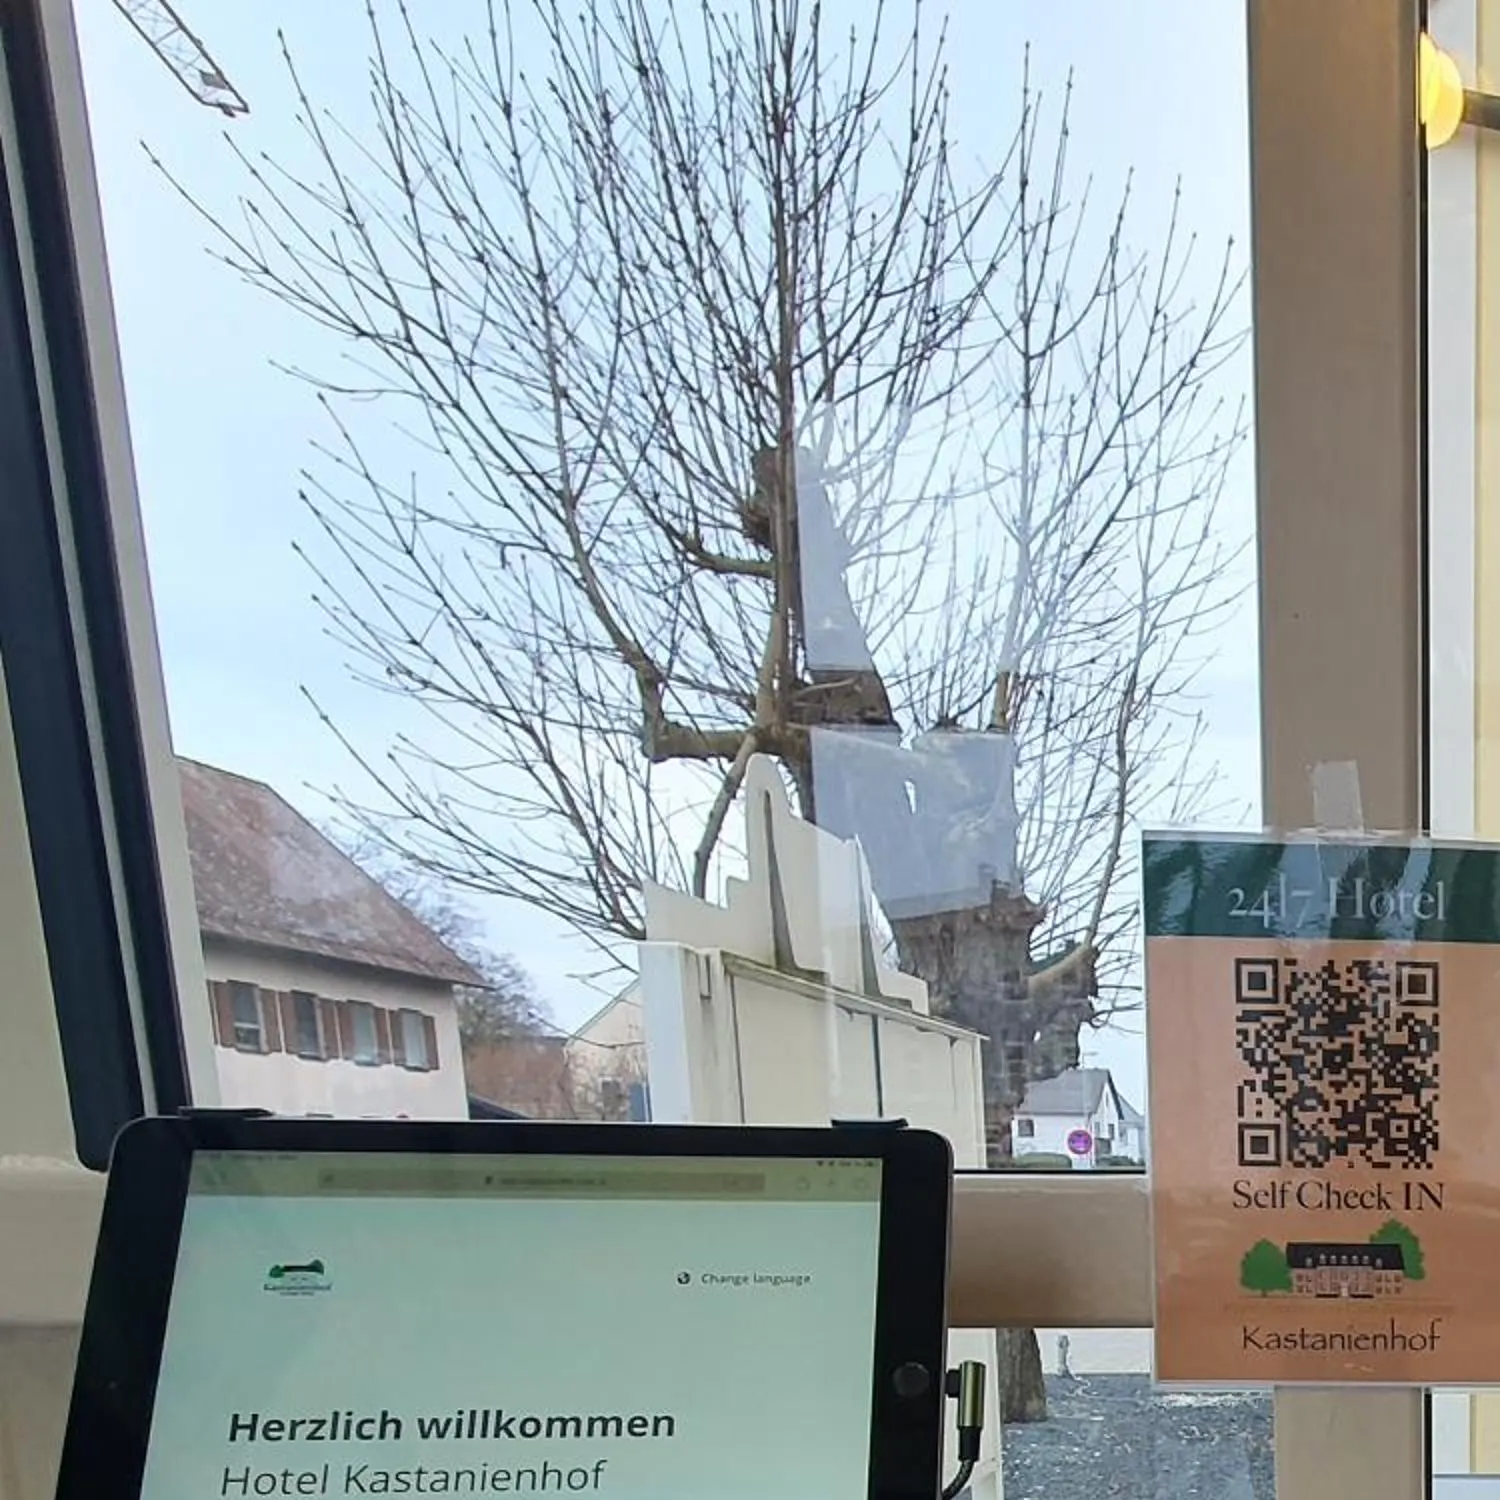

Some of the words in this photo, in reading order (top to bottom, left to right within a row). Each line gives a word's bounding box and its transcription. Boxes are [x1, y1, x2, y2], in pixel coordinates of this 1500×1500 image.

[1329, 876, 1446, 921] Hotel
[1233, 1180, 1299, 1210] Self
[1296, 1180, 1393, 1210] Check
[1403, 1182, 1445, 1212] IN
[701, 1271, 749, 1287] Change
[753, 1271, 811, 1287] language
[1243, 1317, 1443, 1352] Kastanienhof
[229, 1409, 402, 1442] Herzlich
[418, 1408, 677, 1440] willkommen
[221, 1463, 329, 1497] Hotel
[344, 1459, 608, 1494] Kastanienhof
